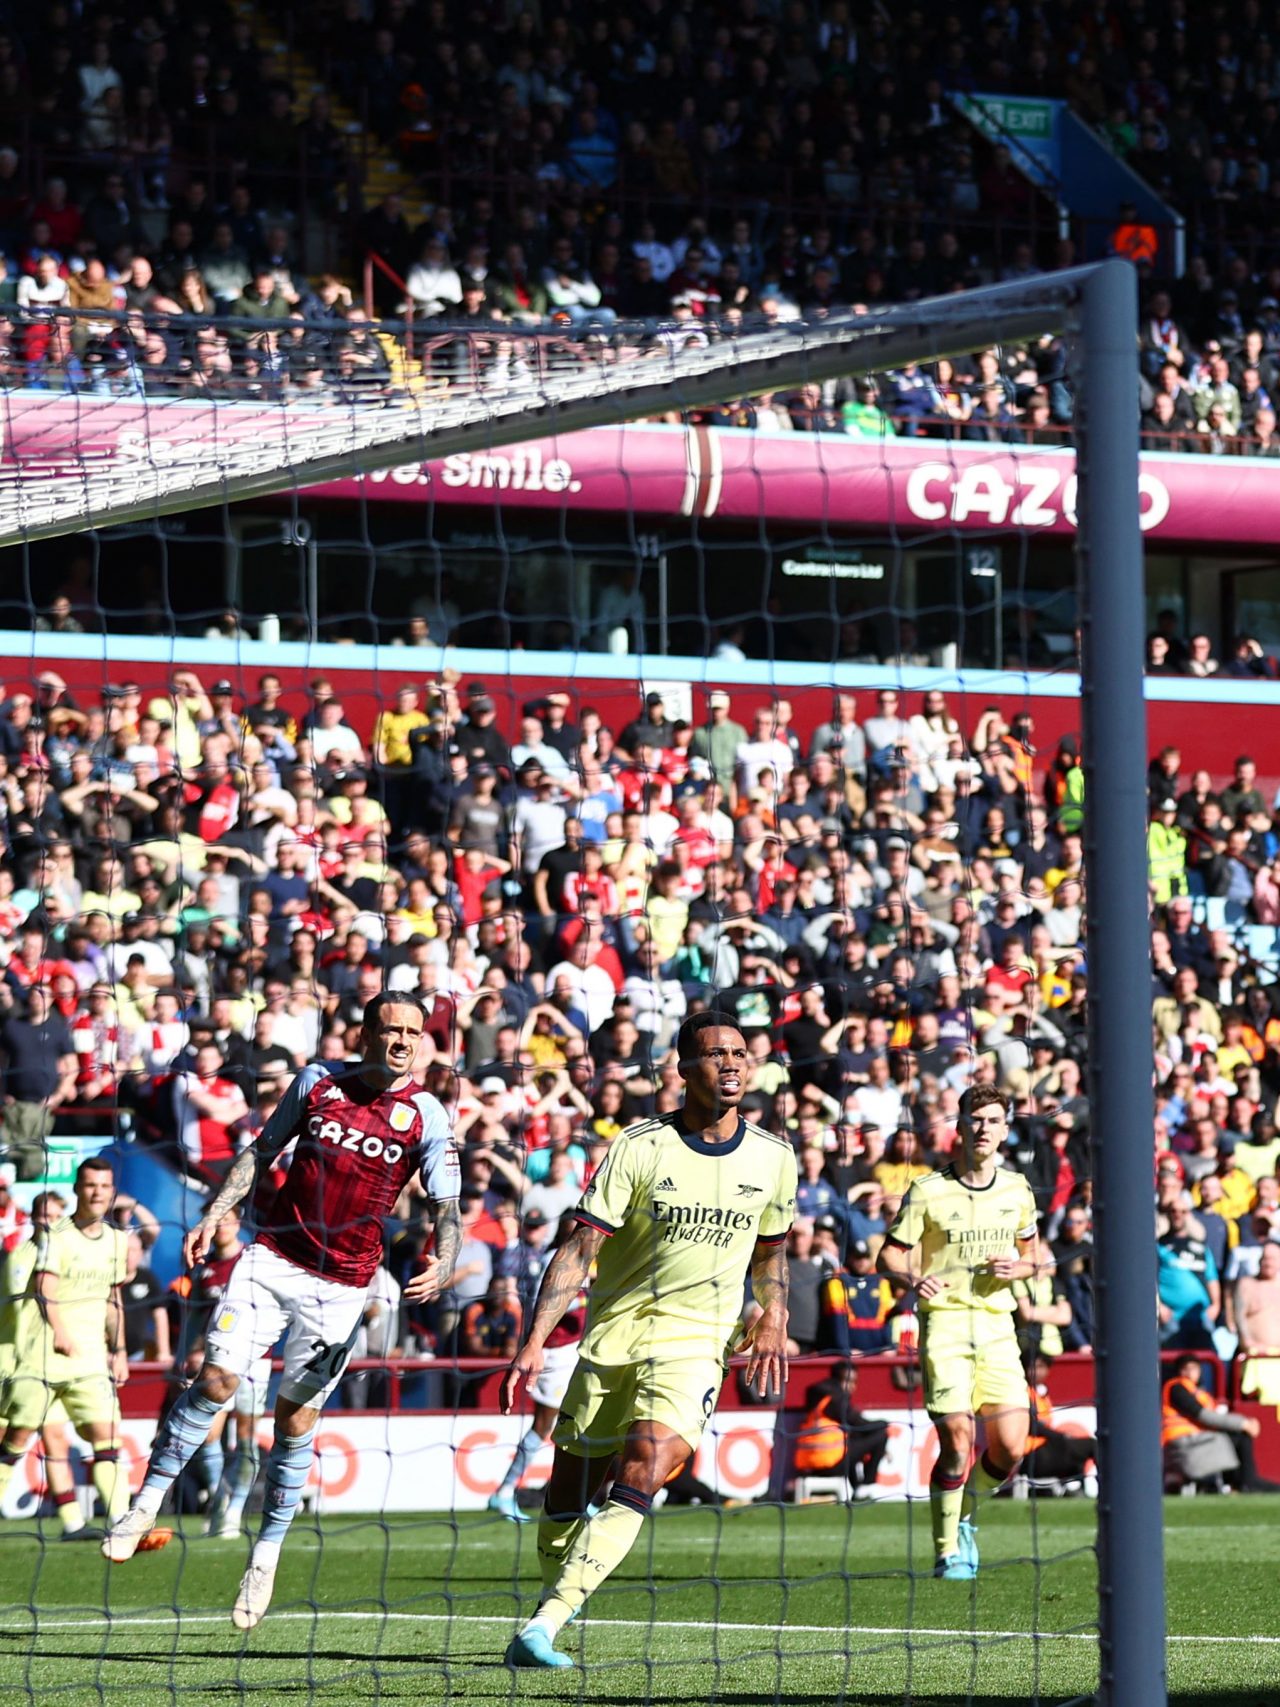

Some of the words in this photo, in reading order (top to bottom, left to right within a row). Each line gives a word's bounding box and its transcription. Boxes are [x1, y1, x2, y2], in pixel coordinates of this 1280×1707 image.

[1006, 109, 1046, 131] EXIT
[442, 452, 583, 493] Smile.
[906, 461, 1170, 531] CAZO
[968, 551, 995, 569] 12
[308, 1115, 403, 1164] CAZOO
[655, 1184, 677, 1192] adidas
[652, 1201, 755, 1230] Emirates
[304, 1339, 348, 1378] 20
[702, 1386, 716, 1419] 6
[579, 1553, 605, 1573] AFC
